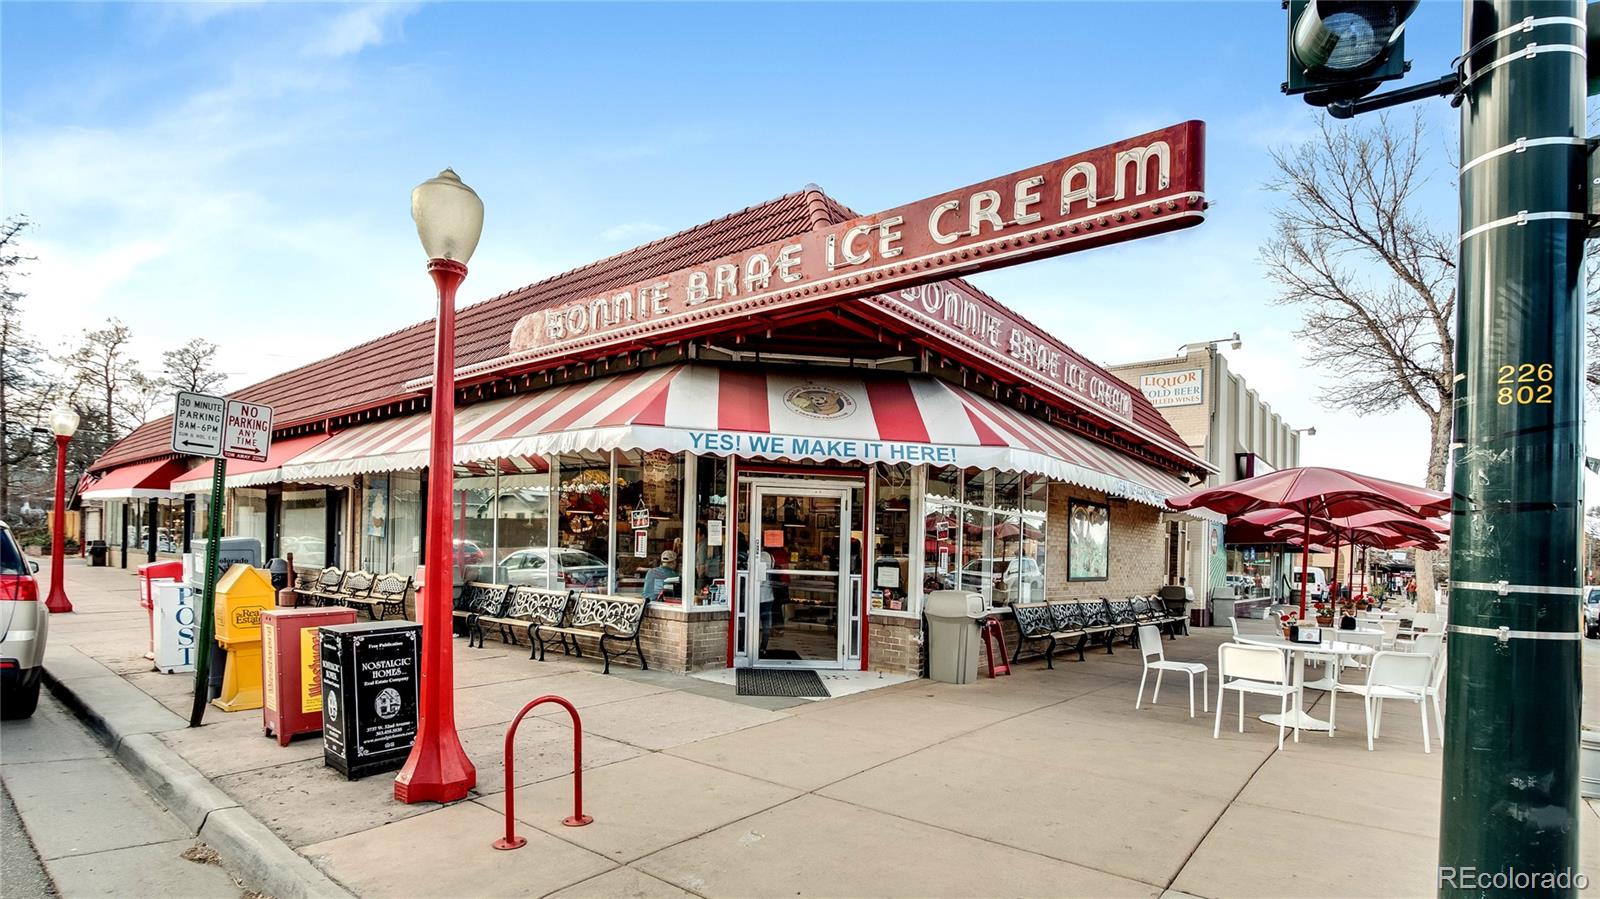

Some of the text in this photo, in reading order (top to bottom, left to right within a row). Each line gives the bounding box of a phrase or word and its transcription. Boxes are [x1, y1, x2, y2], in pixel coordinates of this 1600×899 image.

[686, 244, 803, 305] BRAE
[825, 215, 904, 271] ICE
[928, 141, 1171, 246] CREAM
[1497, 363, 1553, 384] 226
[1144, 372, 1197, 390] LIQUOR
[1174, 386, 1201, 396] BEER
[1497, 385, 1553, 405] 802
[180, 398, 222, 412] 30 MINUTE
[241, 405, 258, 418] NO
[180, 410, 220, 423] PARKING
[228, 415, 268, 432] PARKING
[238, 429, 257, 438] ANY
[236, 437, 257, 447] TIME
[689, 431, 957, 462] YES! WE MAKE IT HERE!
[176, 588, 195, 665] POST
[361, 657, 412, 671] NOSTALGIC
[372, 667, 402, 679] HOMES
